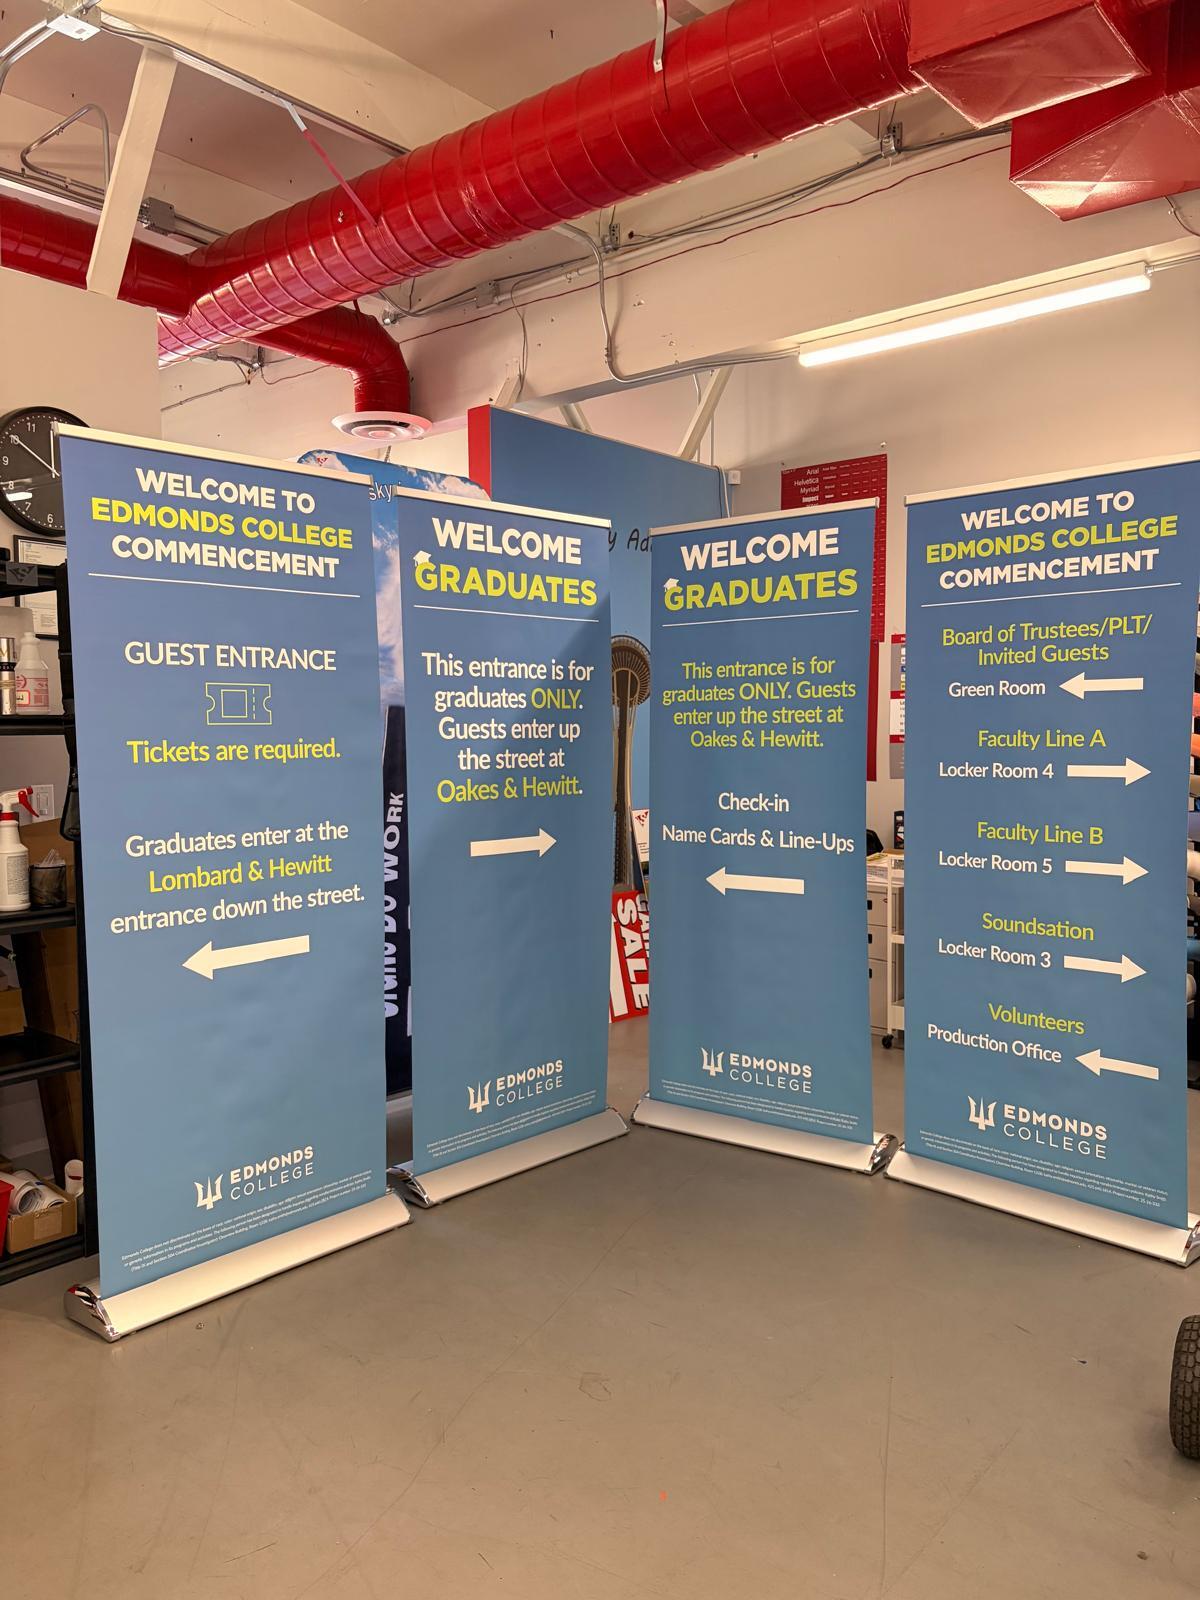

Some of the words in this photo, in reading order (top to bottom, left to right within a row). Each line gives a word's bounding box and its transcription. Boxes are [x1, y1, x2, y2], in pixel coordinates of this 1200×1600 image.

[27, 422, 36, 433] 11
[2, 456, 9, 466] 9
[8, 481, 15, 490] 8
[136, 468, 275, 509] WELCOME
[282, 490, 315, 513] TO
[25, 501, 32, 511] 7
[47, 514, 54, 524] 6
[961, 497, 1089, 530] WELCOME
[1096, 491, 1134, 513] TO
[92, 497, 234, 535] EDMONDS
[242, 517, 352, 548] COLLEGE
[432, 518, 581, 564] WELCOME
[681, 528, 838, 570] WELCOME
[927, 532, 1045, 563] EDMONDS
[1052, 515, 1177, 548] COLLEGE
[112, 535, 339, 578] COMMENCEMENT
[939, 549, 1159, 589] COMMENCEMENT
[414, 563, 597, 606] GRADUATES
[664, 569, 857, 610] GRADUATES
[943, 626, 992, 645] Board
[998, 624, 1015, 642] of
[1020, 614, 1152, 640] Trustees/PLT/
[125, 642, 209, 665] GUEST
[216, 645, 336, 670] ENTRANCE
[422, 652, 463, 676] This
[469, 658, 546, 679] entrance
[552, 659, 563, 680] is
[568, 660, 594, 680] for
[682, 662, 712, 679] This
[717, 662, 787, 677] entrance
[793, 657, 804, 674] is
[810, 656, 835, 673] for
[979, 646, 1036, 665] Invited
[1042, 644, 1109, 662] Guests
[435, 686, 526, 712] graduates
[531, 688, 583, 709] ONLY.
[663, 685, 734, 705] graduates
[739, 682, 791, 699] ONLY.
[797, 681, 855, 698] Guests
[949, 682, 994, 697] Green
[1000, 681, 1045, 695] Room
[439, 717, 506, 739] Guests
[511, 719, 554, 738] enter
[559, 724, 580, 742] up
[674, 709, 712, 724] enter
[717, 711, 735, 727] up
[740, 706, 767, 723] the
[773, 706, 822, 723] street
[827, 706, 843, 722] at
[127, 740, 209, 763] Tickets
[216, 745, 248, 760] are
[255, 738, 340, 763] required.
[691, 730, 737, 747] Oakes
[742, 730, 755, 747] &
[761, 730, 823, 747] Hewitt.
[979, 730, 1040, 750] Faculty
[1047, 730, 1084, 747] Line
[1090, 730, 1106, 747] A
[458, 748, 490, 770] the
[496, 749, 545, 769] street
[549, 748, 564, 767] at
[940, 762, 988, 777] Locker
[993, 763, 1037, 778] Room
[1042, 764, 1054, 778] 4
[437, 779, 498, 802] Oakes
[504, 778, 518, 798] &
[523, 775, 582, 797] Hewitt.
[719, 793, 789, 811] Check-in
[126, 832, 236, 857] Graduates
[242, 827, 291, 847] enter
[296, 824, 313, 842] at
[318, 821, 348, 840] the
[663, 825, 706, 843] Name
[711, 828, 755, 846] Cards
[761, 830, 774, 847] &
[780, 831, 854, 854] Line-Ups
[978, 822, 1039, 844] Faculty
[1045, 825, 1083, 843] Line
[1090, 827, 1103, 844] B
[150, 862, 242, 892] Lombard
[249, 861, 264, 881] &
[270, 855, 332, 878] Hewitt
[940, 851, 987, 868] Locker
[992, 855, 1037, 872] Room
[1043, 859, 1052, 873] 5
[111, 908, 206, 933] entrance
[213, 899, 266, 920] down
[272, 892, 302, 912] the
[308, 885, 364, 907] street.
[983, 913, 1093, 940] Soundsation
[939, 939, 986, 958] Locker
[991, 946, 1035, 966] Room
[1041, 952, 1050, 967] 3
[989, 1003, 1084, 1034] Volunteers
[928, 1024, 1008, 1053] Production
[1012, 1041, 1061, 1062] Office
[496, 1059, 563, 1092] EDMONDS
[729, 1053, 812, 1078] EDMONDS
[496, 1075, 563, 1107] COLLEGE
[729, 1069, 812, 1094] COLLEGE
[1003, 1104, 1107, 1141] EDMONDS
[1003, 1123, 1107, 1160] COLLEGE
[230, 1146, 314, 1184] EDMONDS
[230, 1162, 314, 1200] COLLEGE
